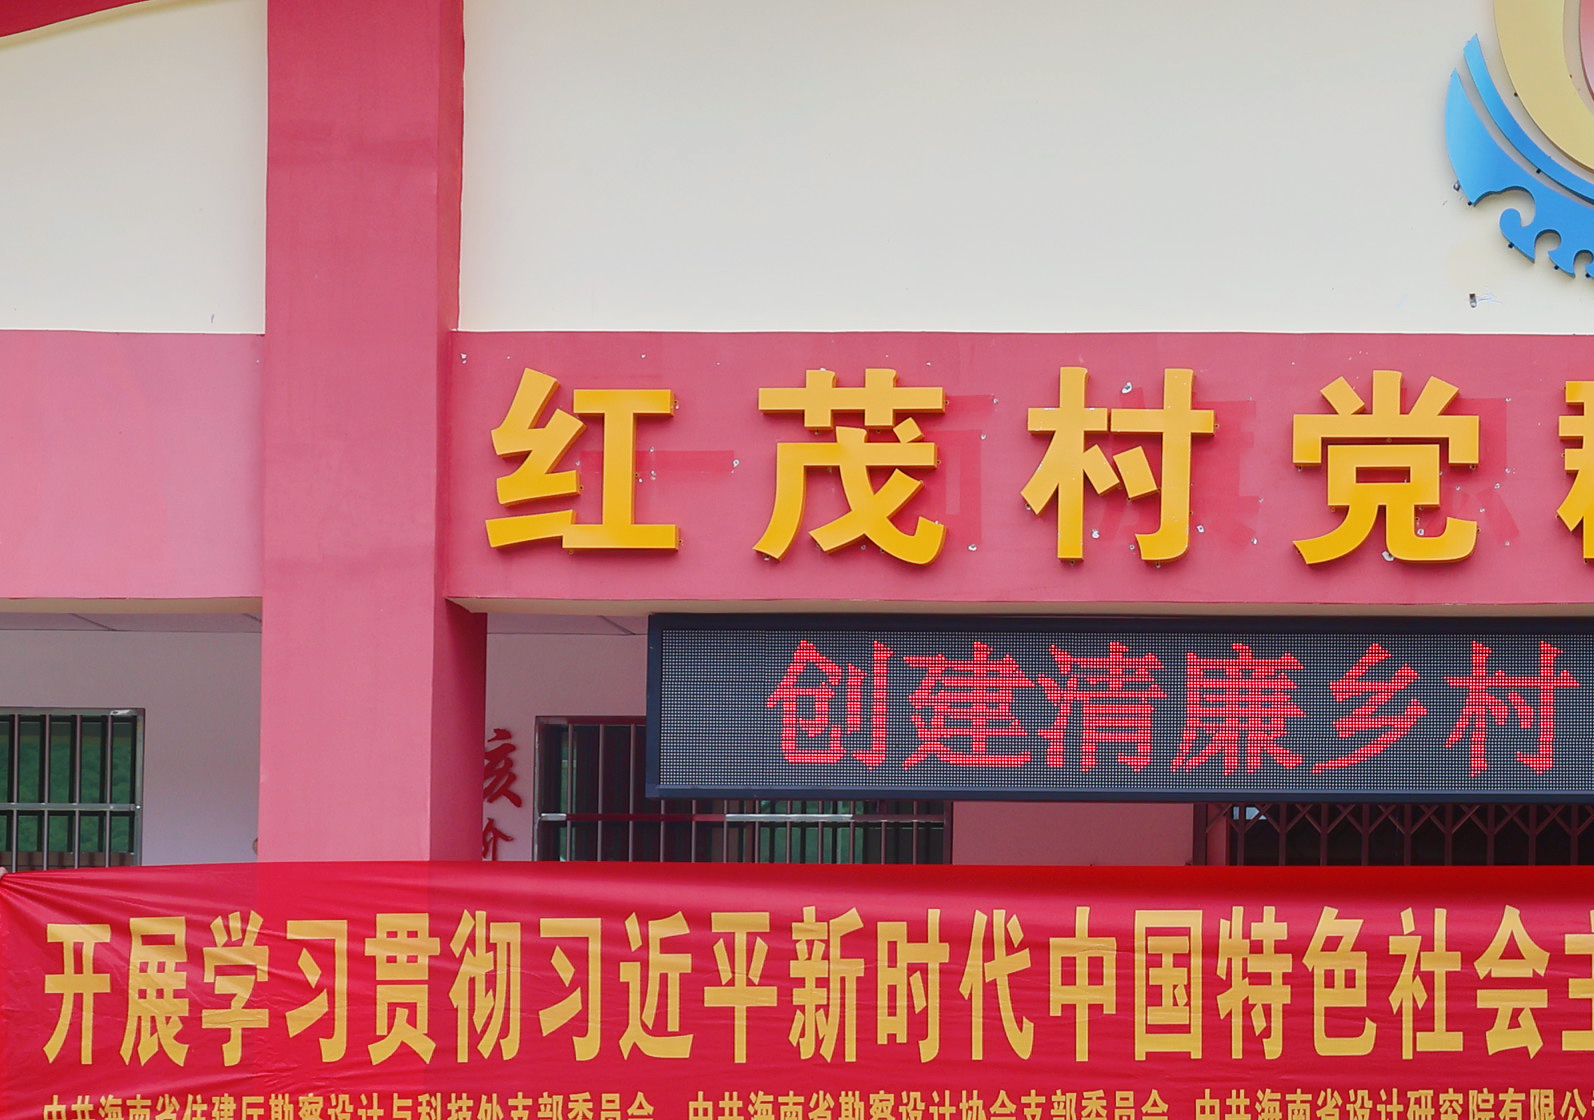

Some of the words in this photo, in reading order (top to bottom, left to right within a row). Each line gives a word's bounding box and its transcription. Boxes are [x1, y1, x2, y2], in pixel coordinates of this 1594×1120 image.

[766, 640, 1580, 775] 创建清廉乡村
